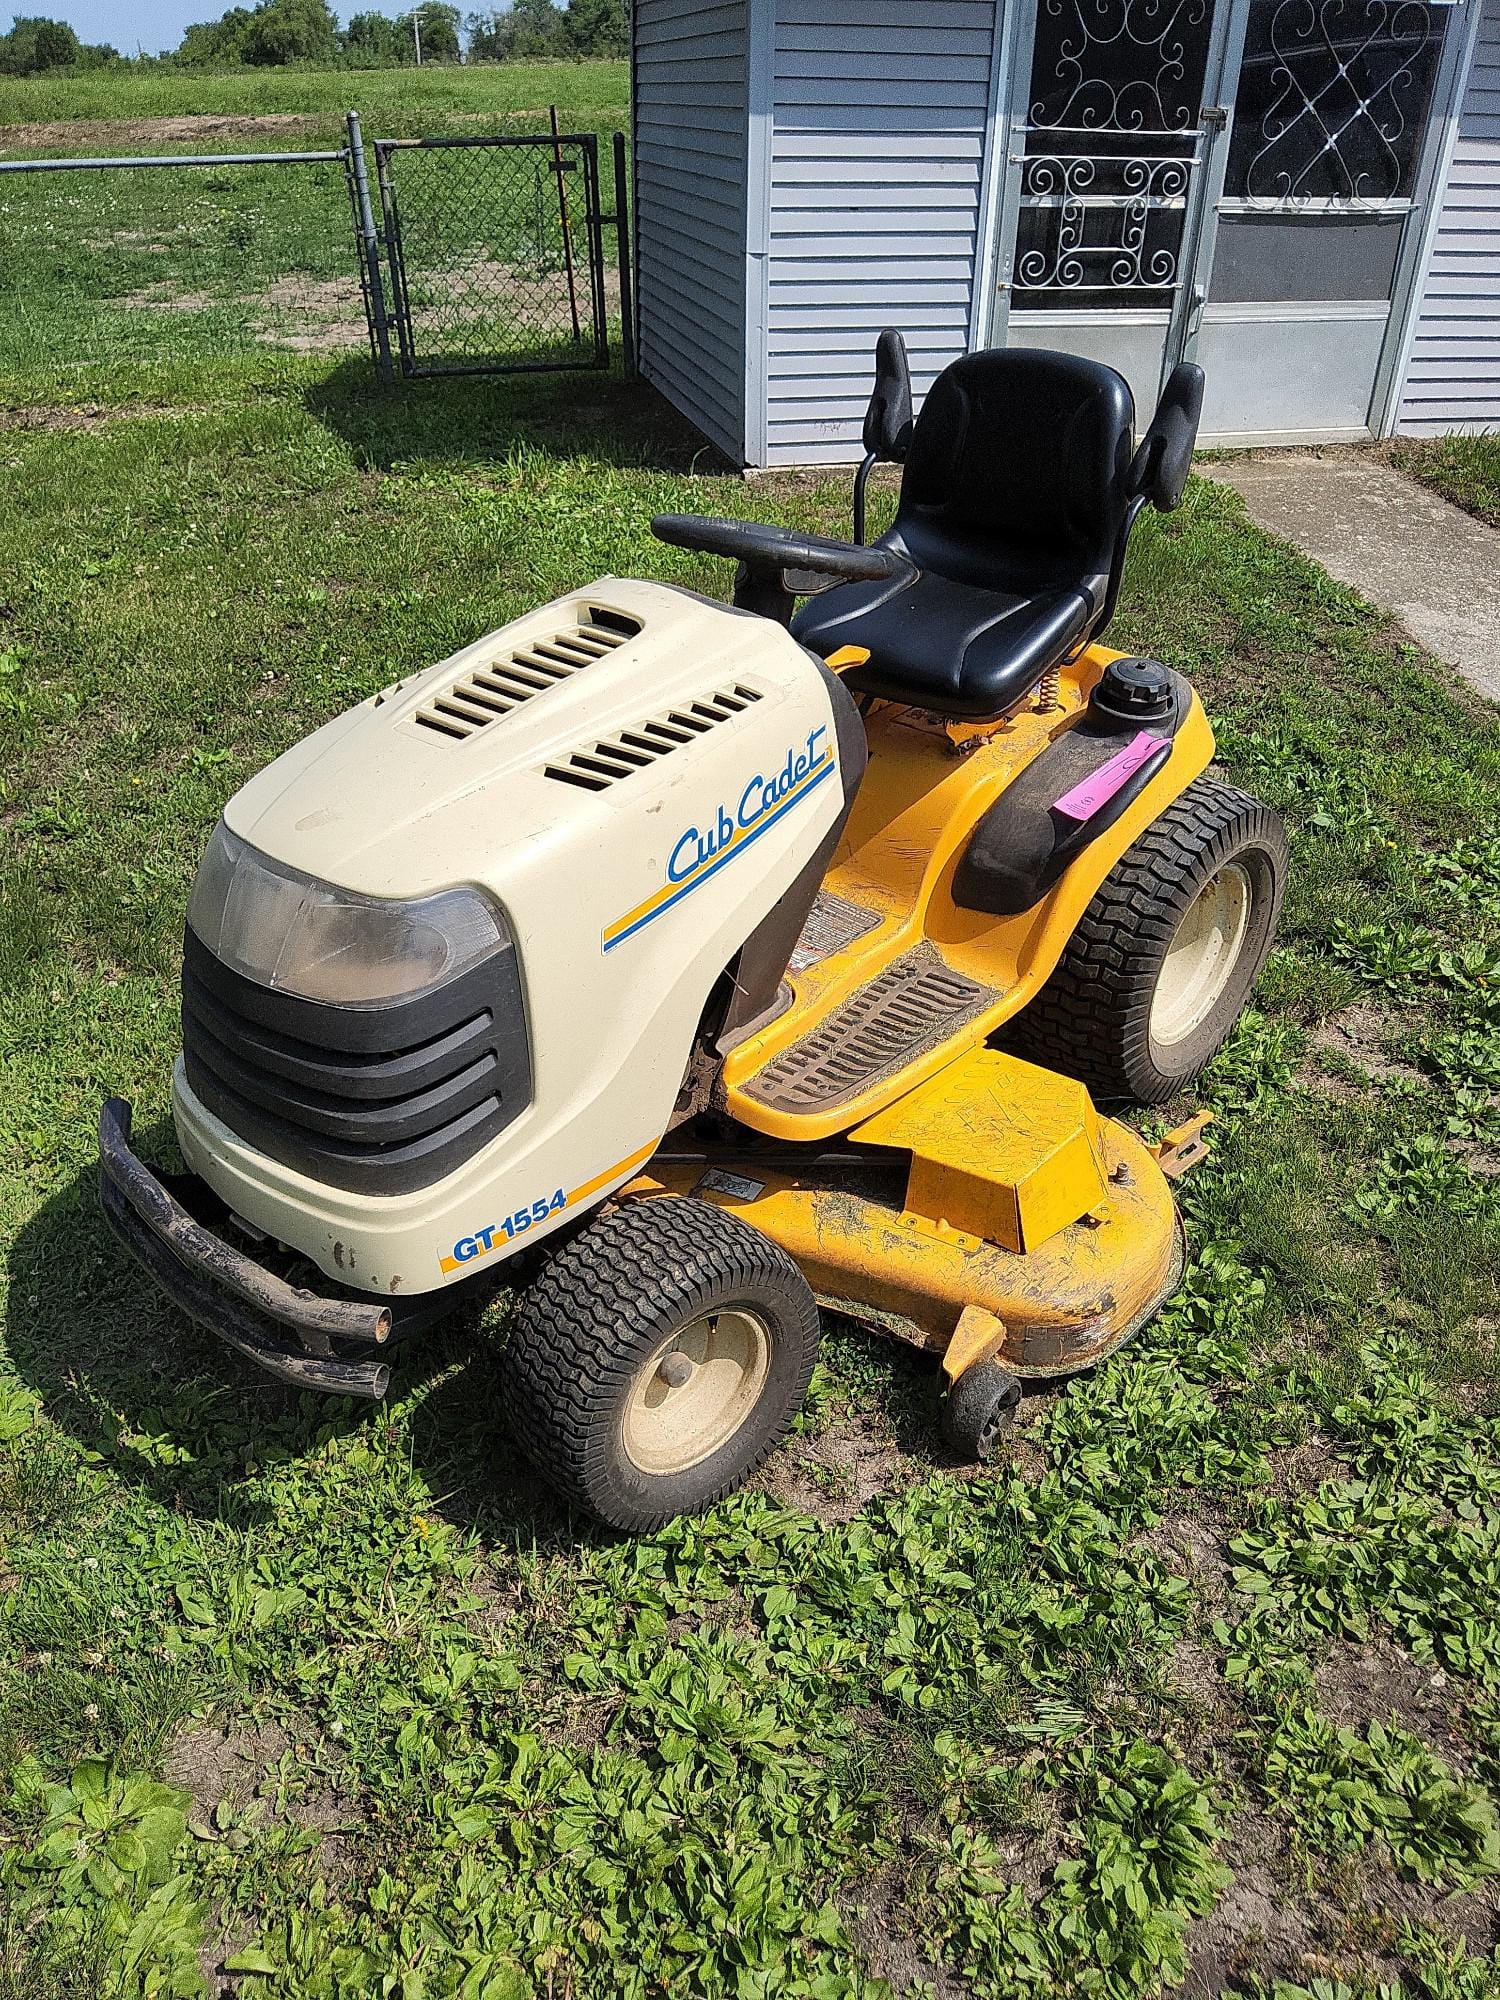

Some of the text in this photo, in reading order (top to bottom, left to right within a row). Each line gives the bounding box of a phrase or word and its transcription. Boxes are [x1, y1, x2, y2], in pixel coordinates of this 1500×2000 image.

[668, 724, 826, 883] Cub Cadet
[453, 1189, 567, 1262] GT 1554
